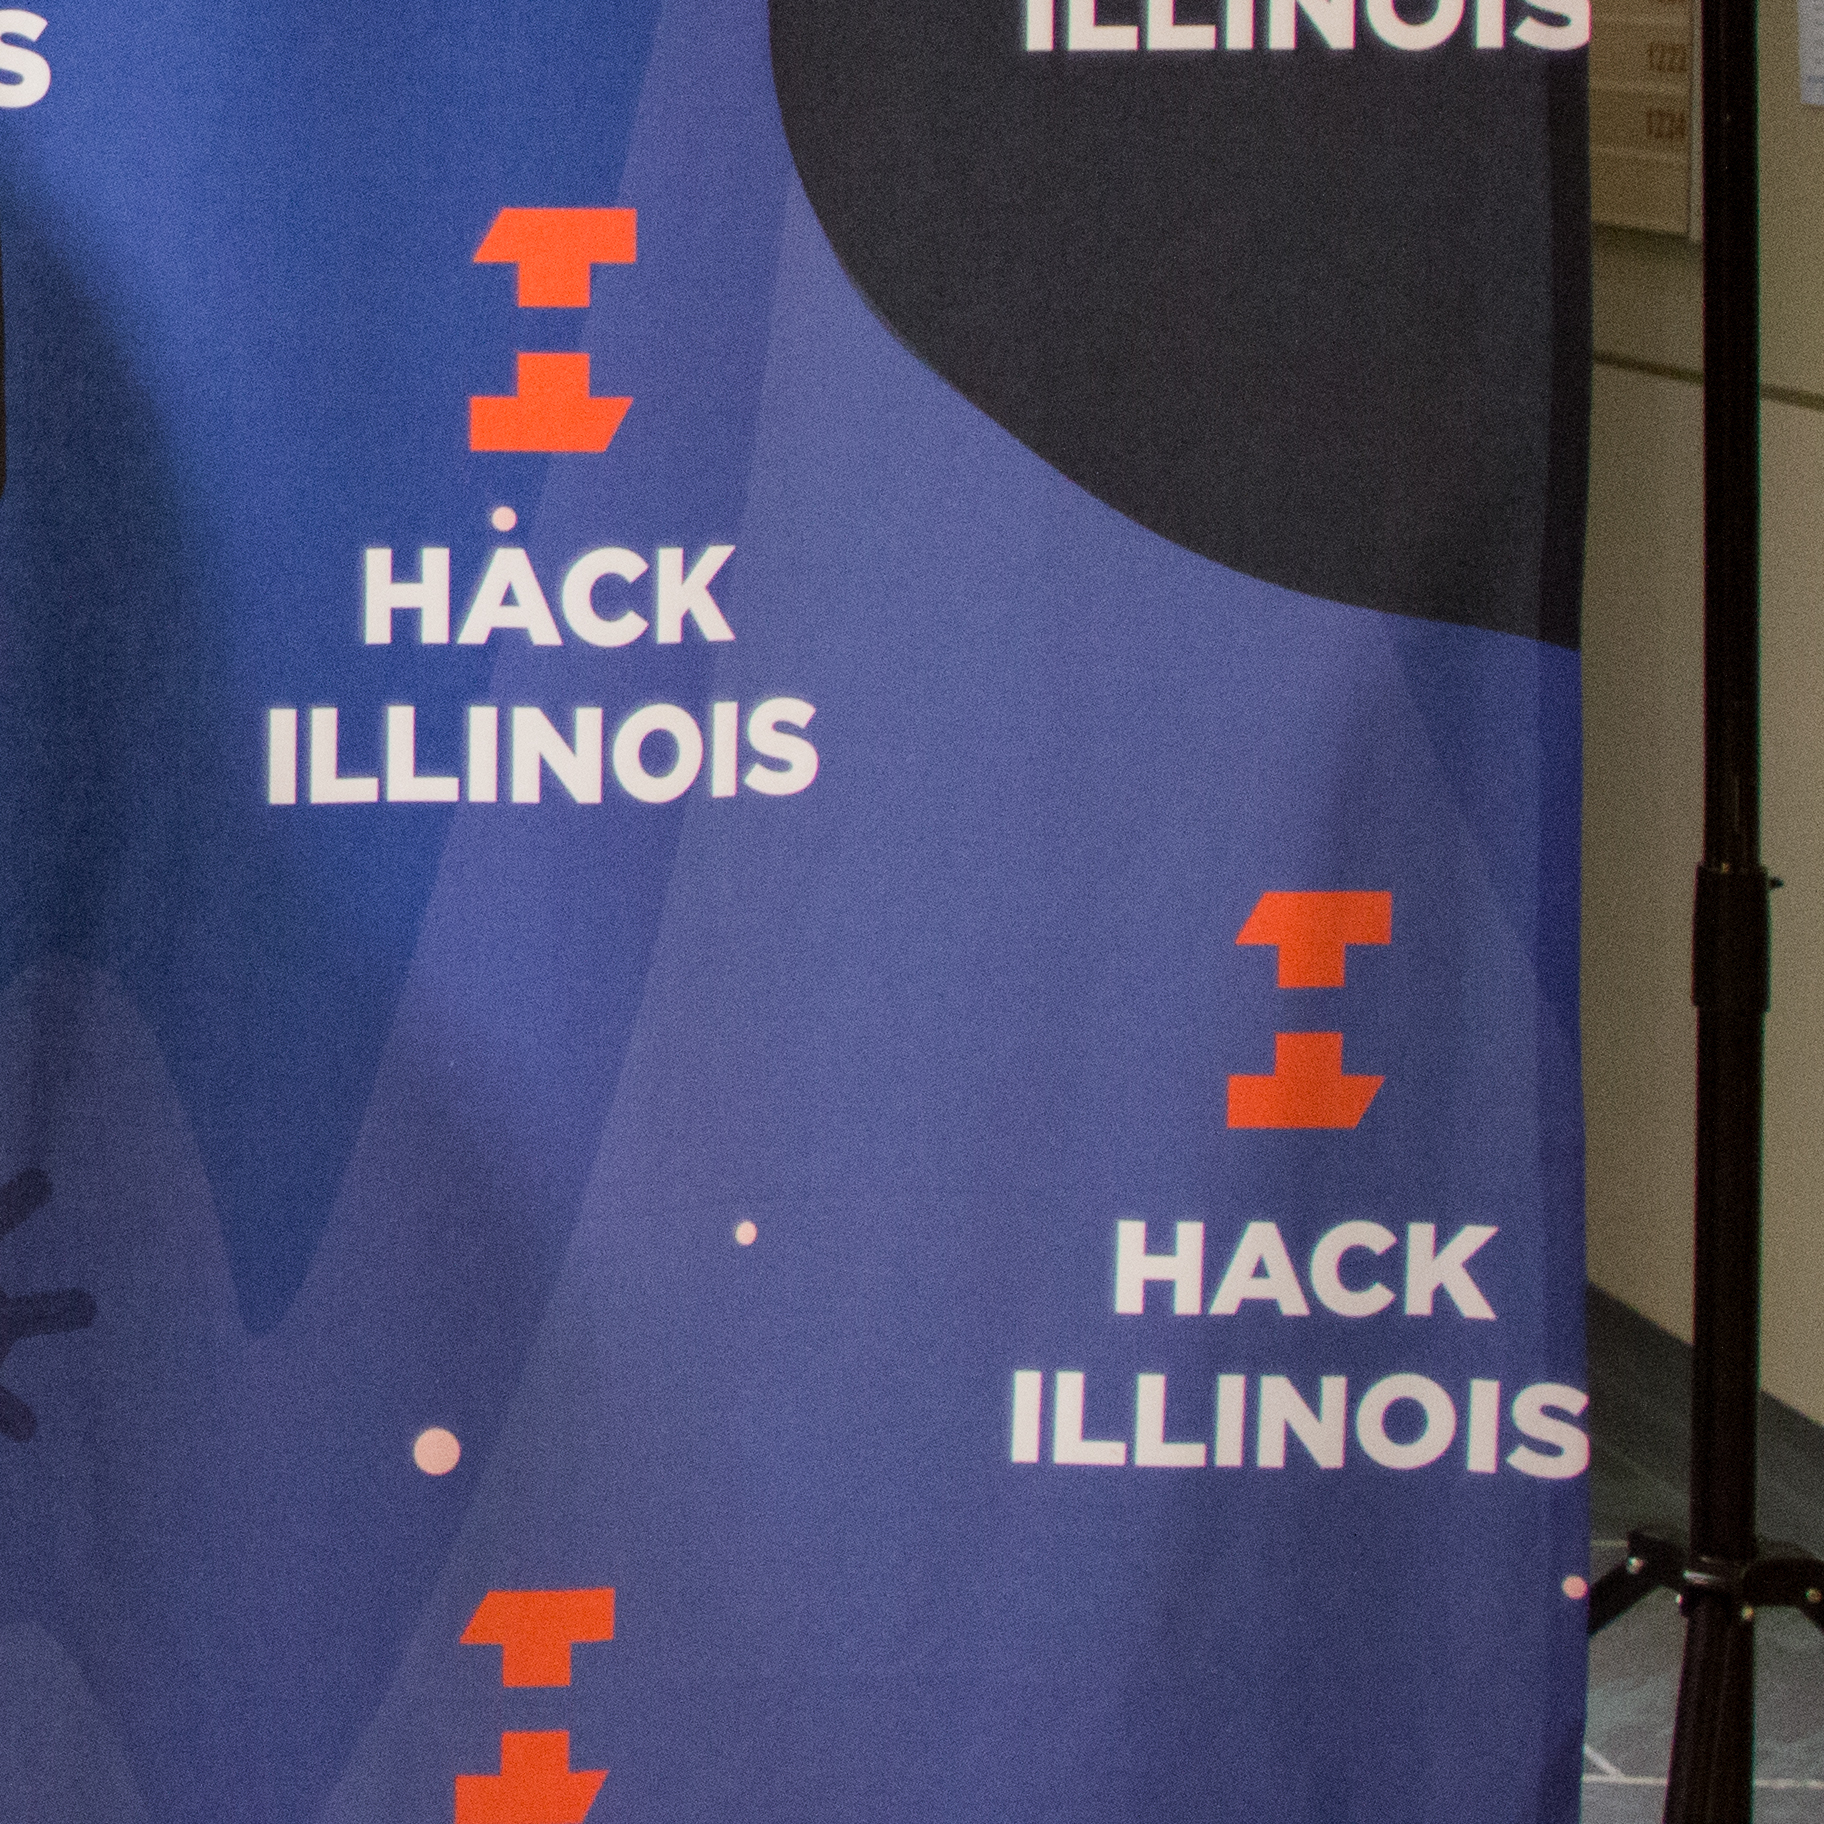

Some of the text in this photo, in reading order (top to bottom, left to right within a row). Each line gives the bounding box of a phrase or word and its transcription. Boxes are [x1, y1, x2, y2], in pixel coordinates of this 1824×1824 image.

[362, 541, 737, 650] HACK
[265, 694, 820, 806] ILLINOIS
[1109, 1215, 1499, 1322] HACK
[1006, 1364, 1588, 1481] ILLINOIS
